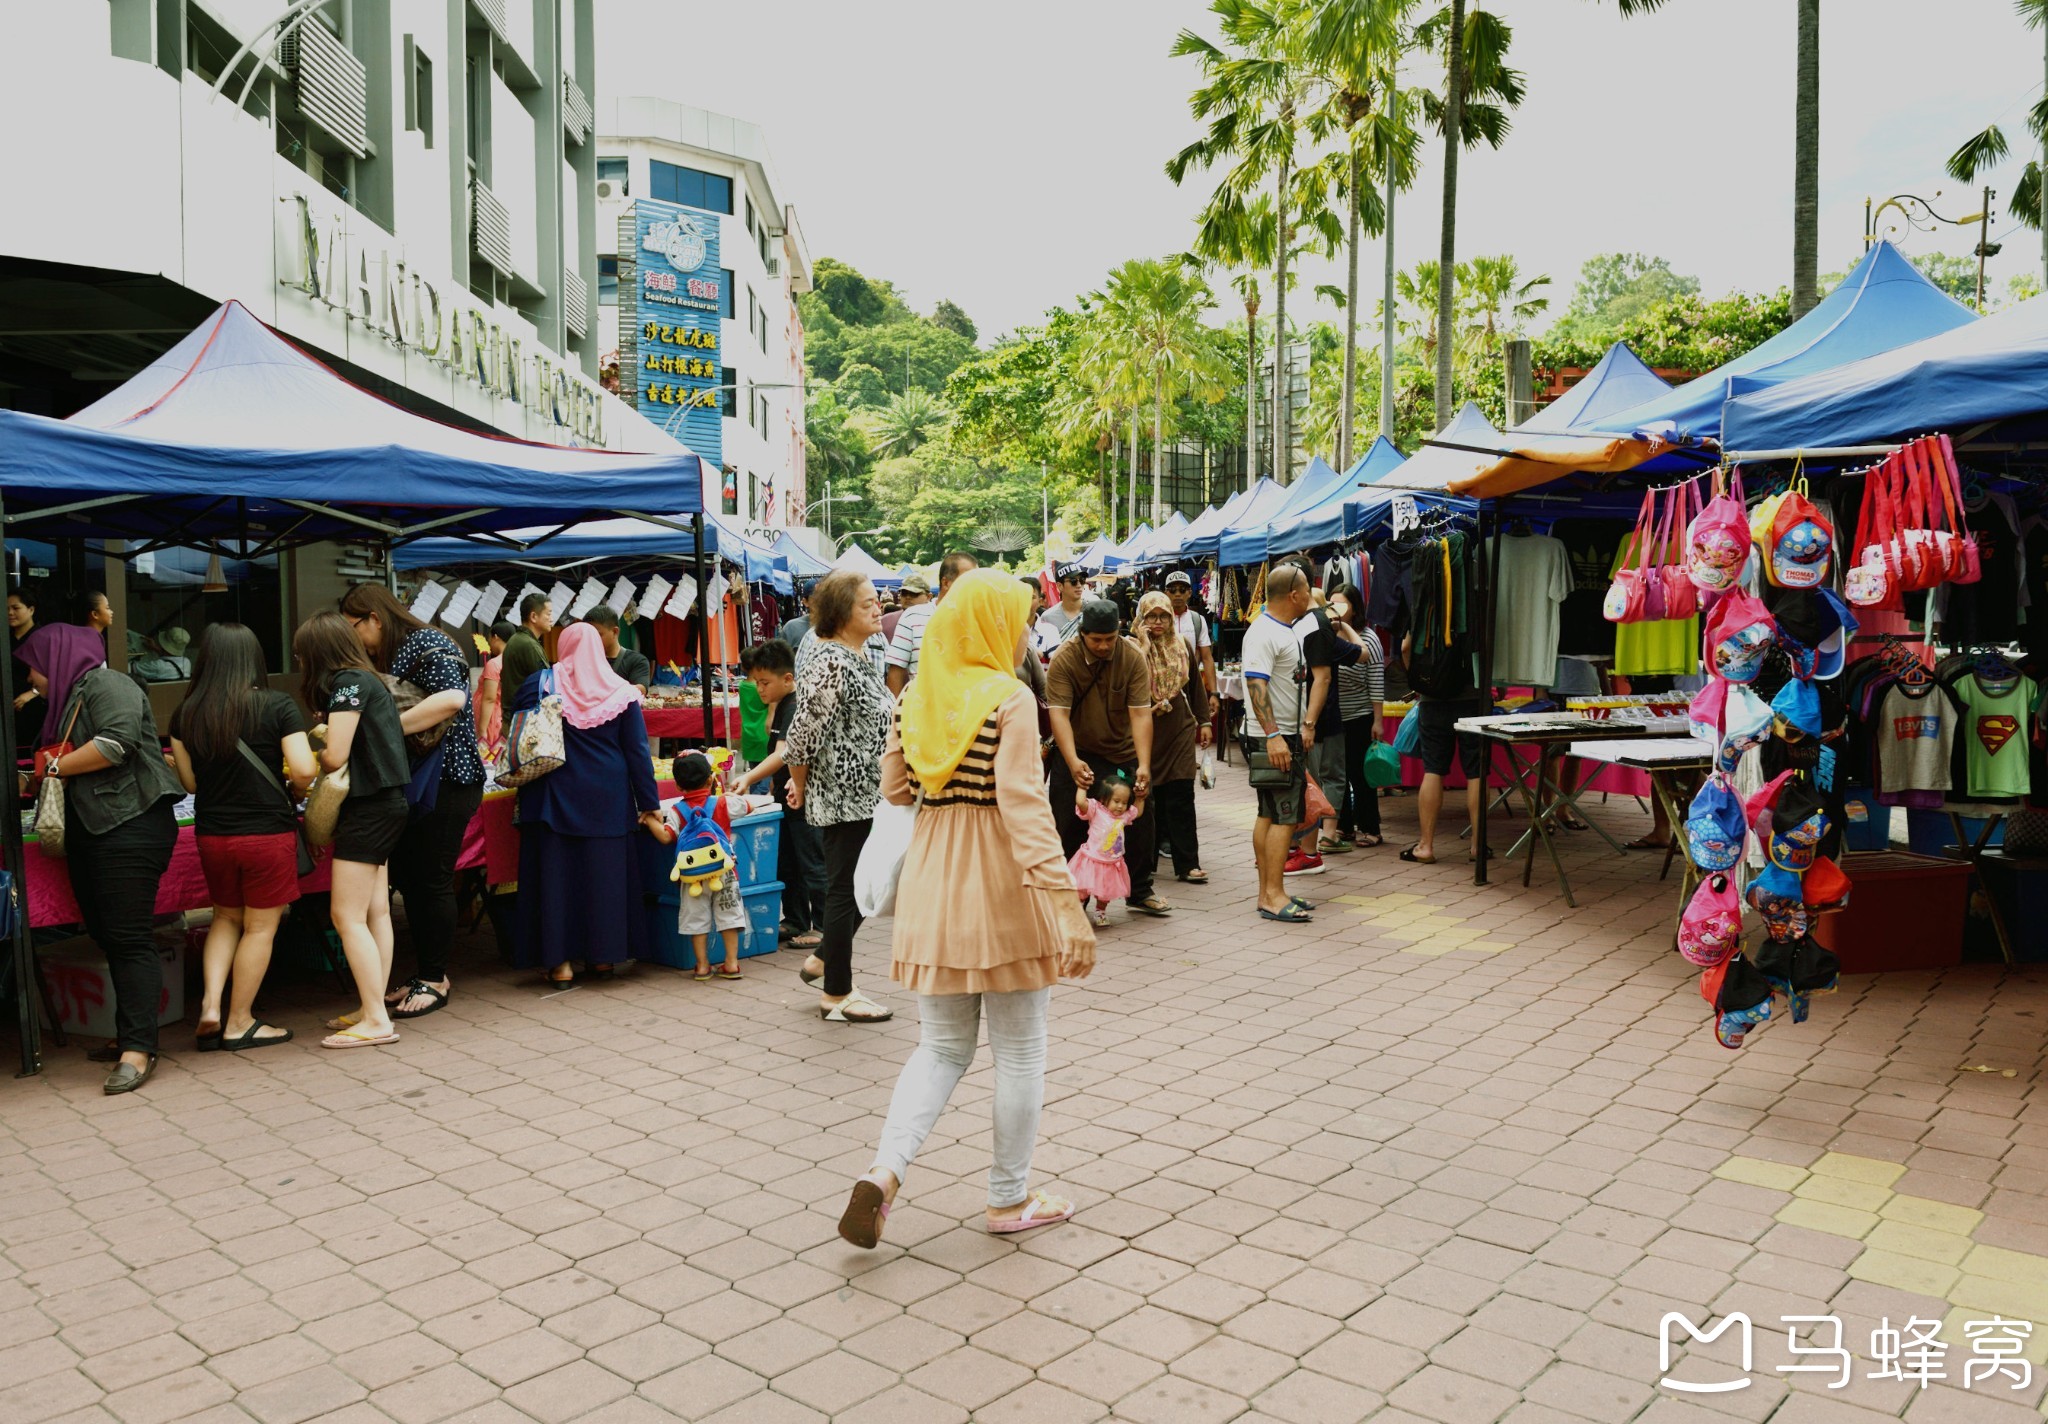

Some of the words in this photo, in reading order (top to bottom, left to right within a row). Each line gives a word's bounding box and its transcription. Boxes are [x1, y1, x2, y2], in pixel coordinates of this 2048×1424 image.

[645, 270, 676, 292] 海鮮
[687, 278, 719, 299] 餐廳
[645, 292, 677, 304] Seafood
[677, 297, 719, 311] Restaurant
[533, 352, 607, 447] HOTEL
[1785, 570, 1815, 579] THOMAS
